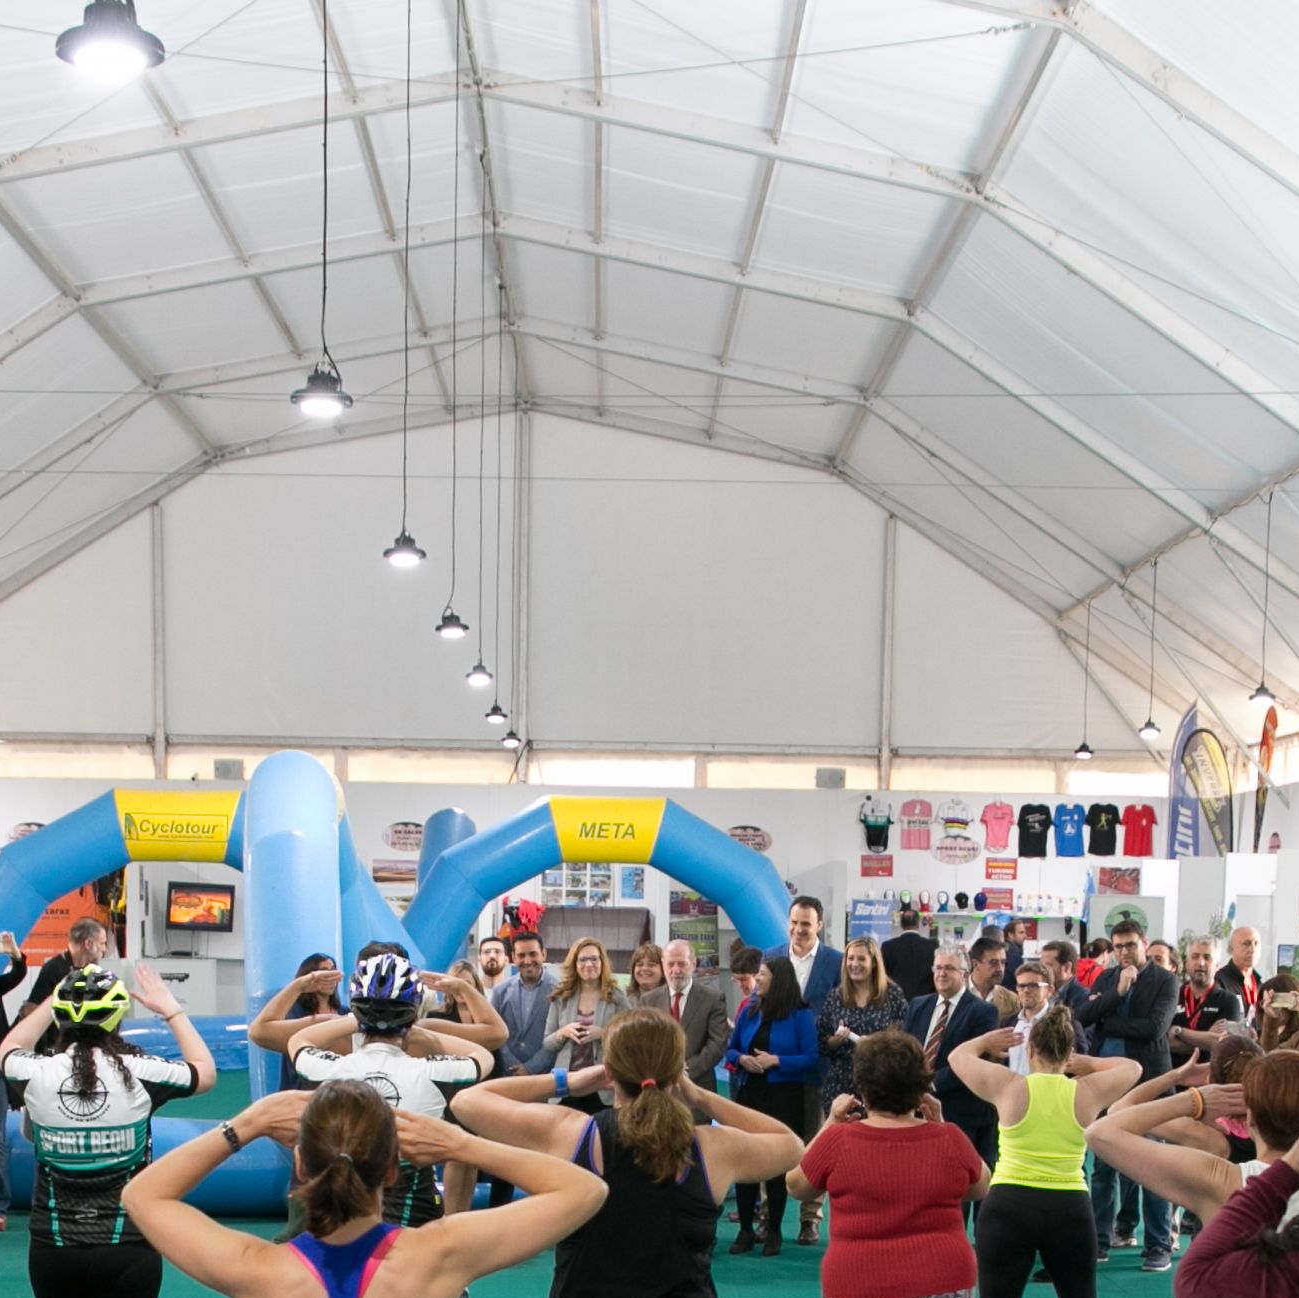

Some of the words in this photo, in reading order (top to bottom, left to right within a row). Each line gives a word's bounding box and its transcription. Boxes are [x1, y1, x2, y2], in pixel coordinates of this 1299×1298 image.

[139, 819, 219, 836] Cyclotour
[579, 822, 636, 840] META
[39, 1129, 88, 1154] SPORT
[90, 1127, 136, 1155] BEQUI
